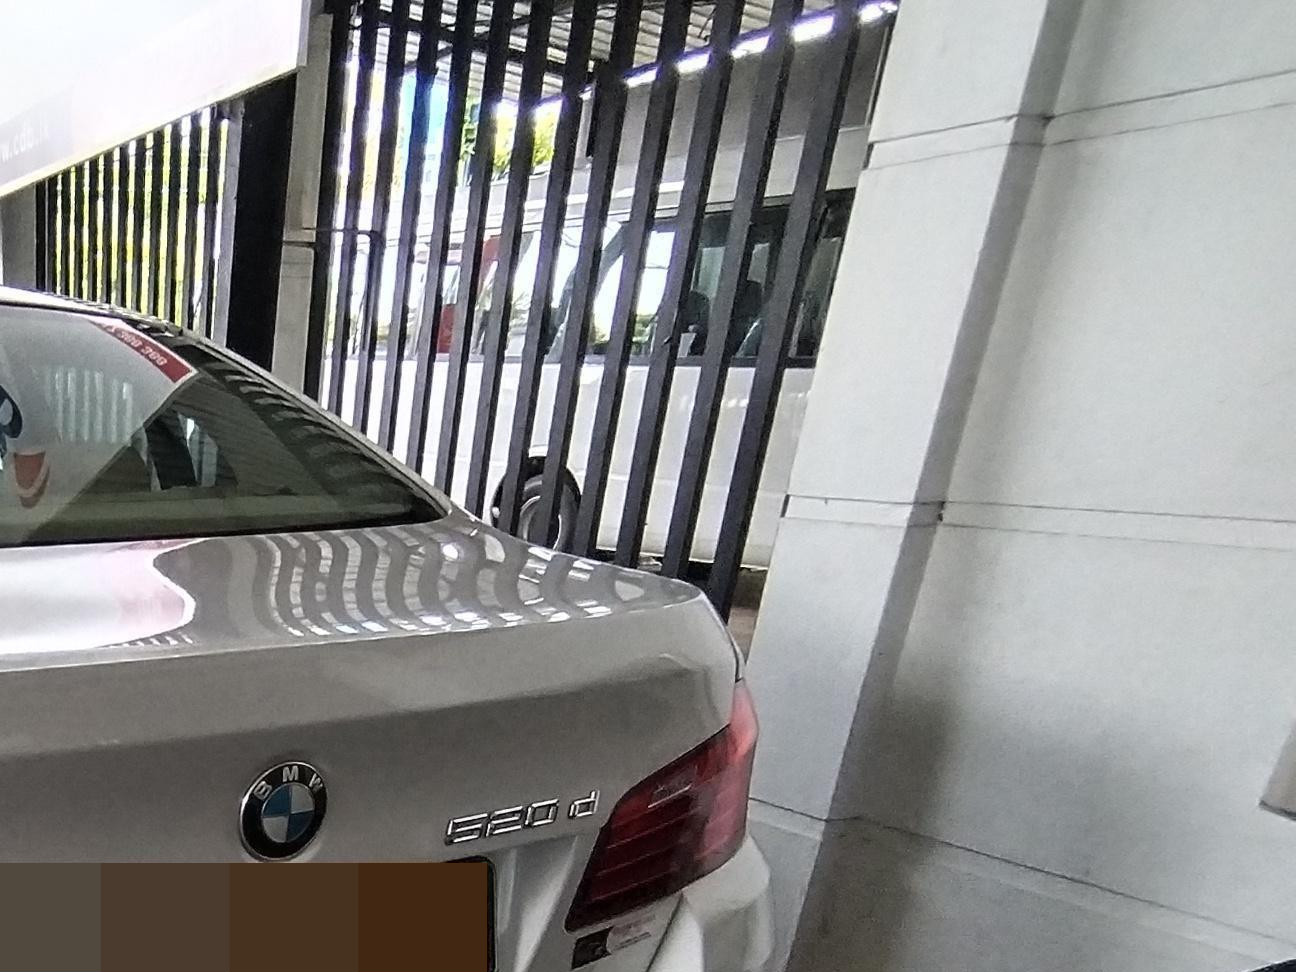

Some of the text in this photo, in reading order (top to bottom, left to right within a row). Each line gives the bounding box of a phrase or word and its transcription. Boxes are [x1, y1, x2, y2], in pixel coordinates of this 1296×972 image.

[253, 765, 323, 800] BMW
[445, 789, 600, 845] 520 d
